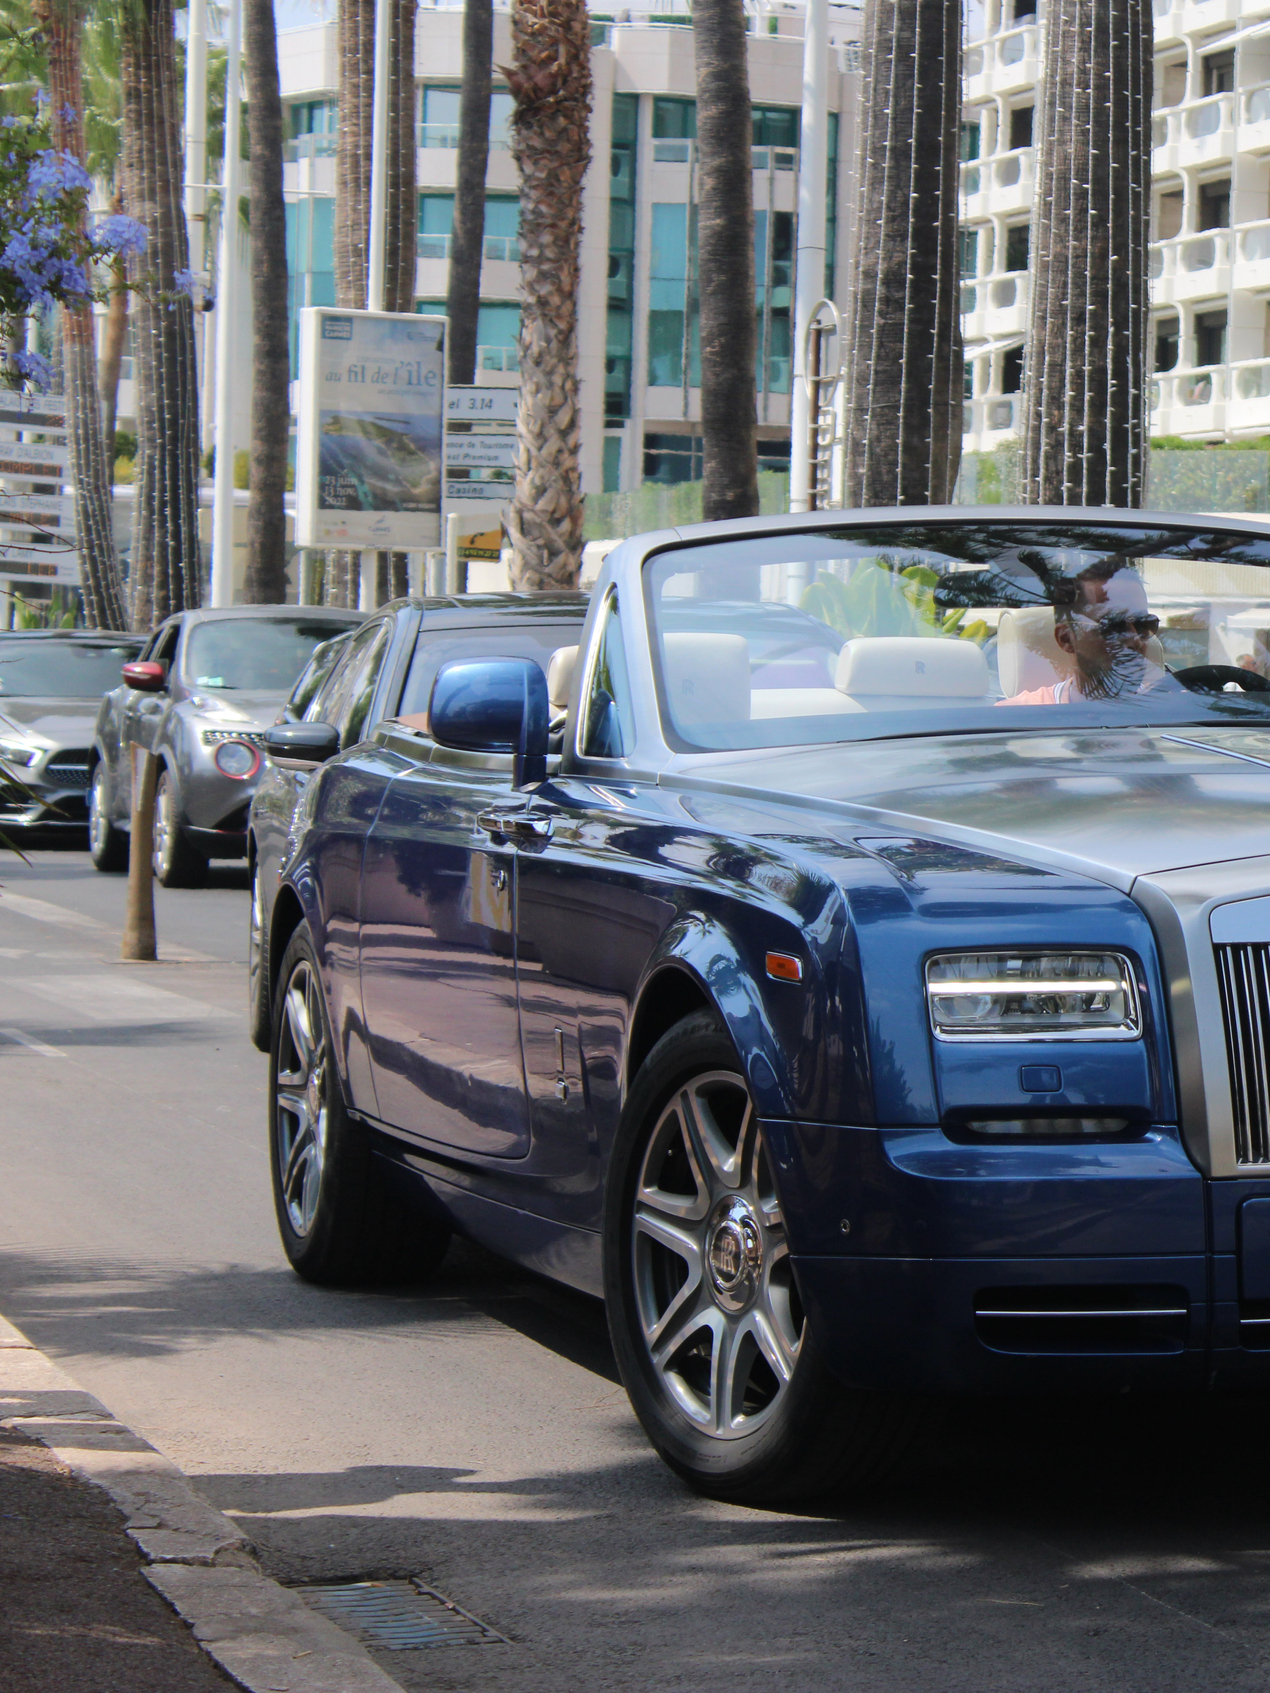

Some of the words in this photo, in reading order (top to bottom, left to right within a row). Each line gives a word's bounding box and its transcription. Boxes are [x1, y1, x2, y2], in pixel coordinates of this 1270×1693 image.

[325, 371, 342, 382] au
[347, 364, 366, 383] fil
[371, 366, 389, 384] de
[468, 398, 493, 410] 3.14
[325, 475, 336, 486] 23
[324, 486, 334, 496] 13
[336, 487, 356, 496] nov.
[447, 485, 484, 494] Casino
[325, 497, 346, 505] 2022
[915, 660, 926, 674] RR
